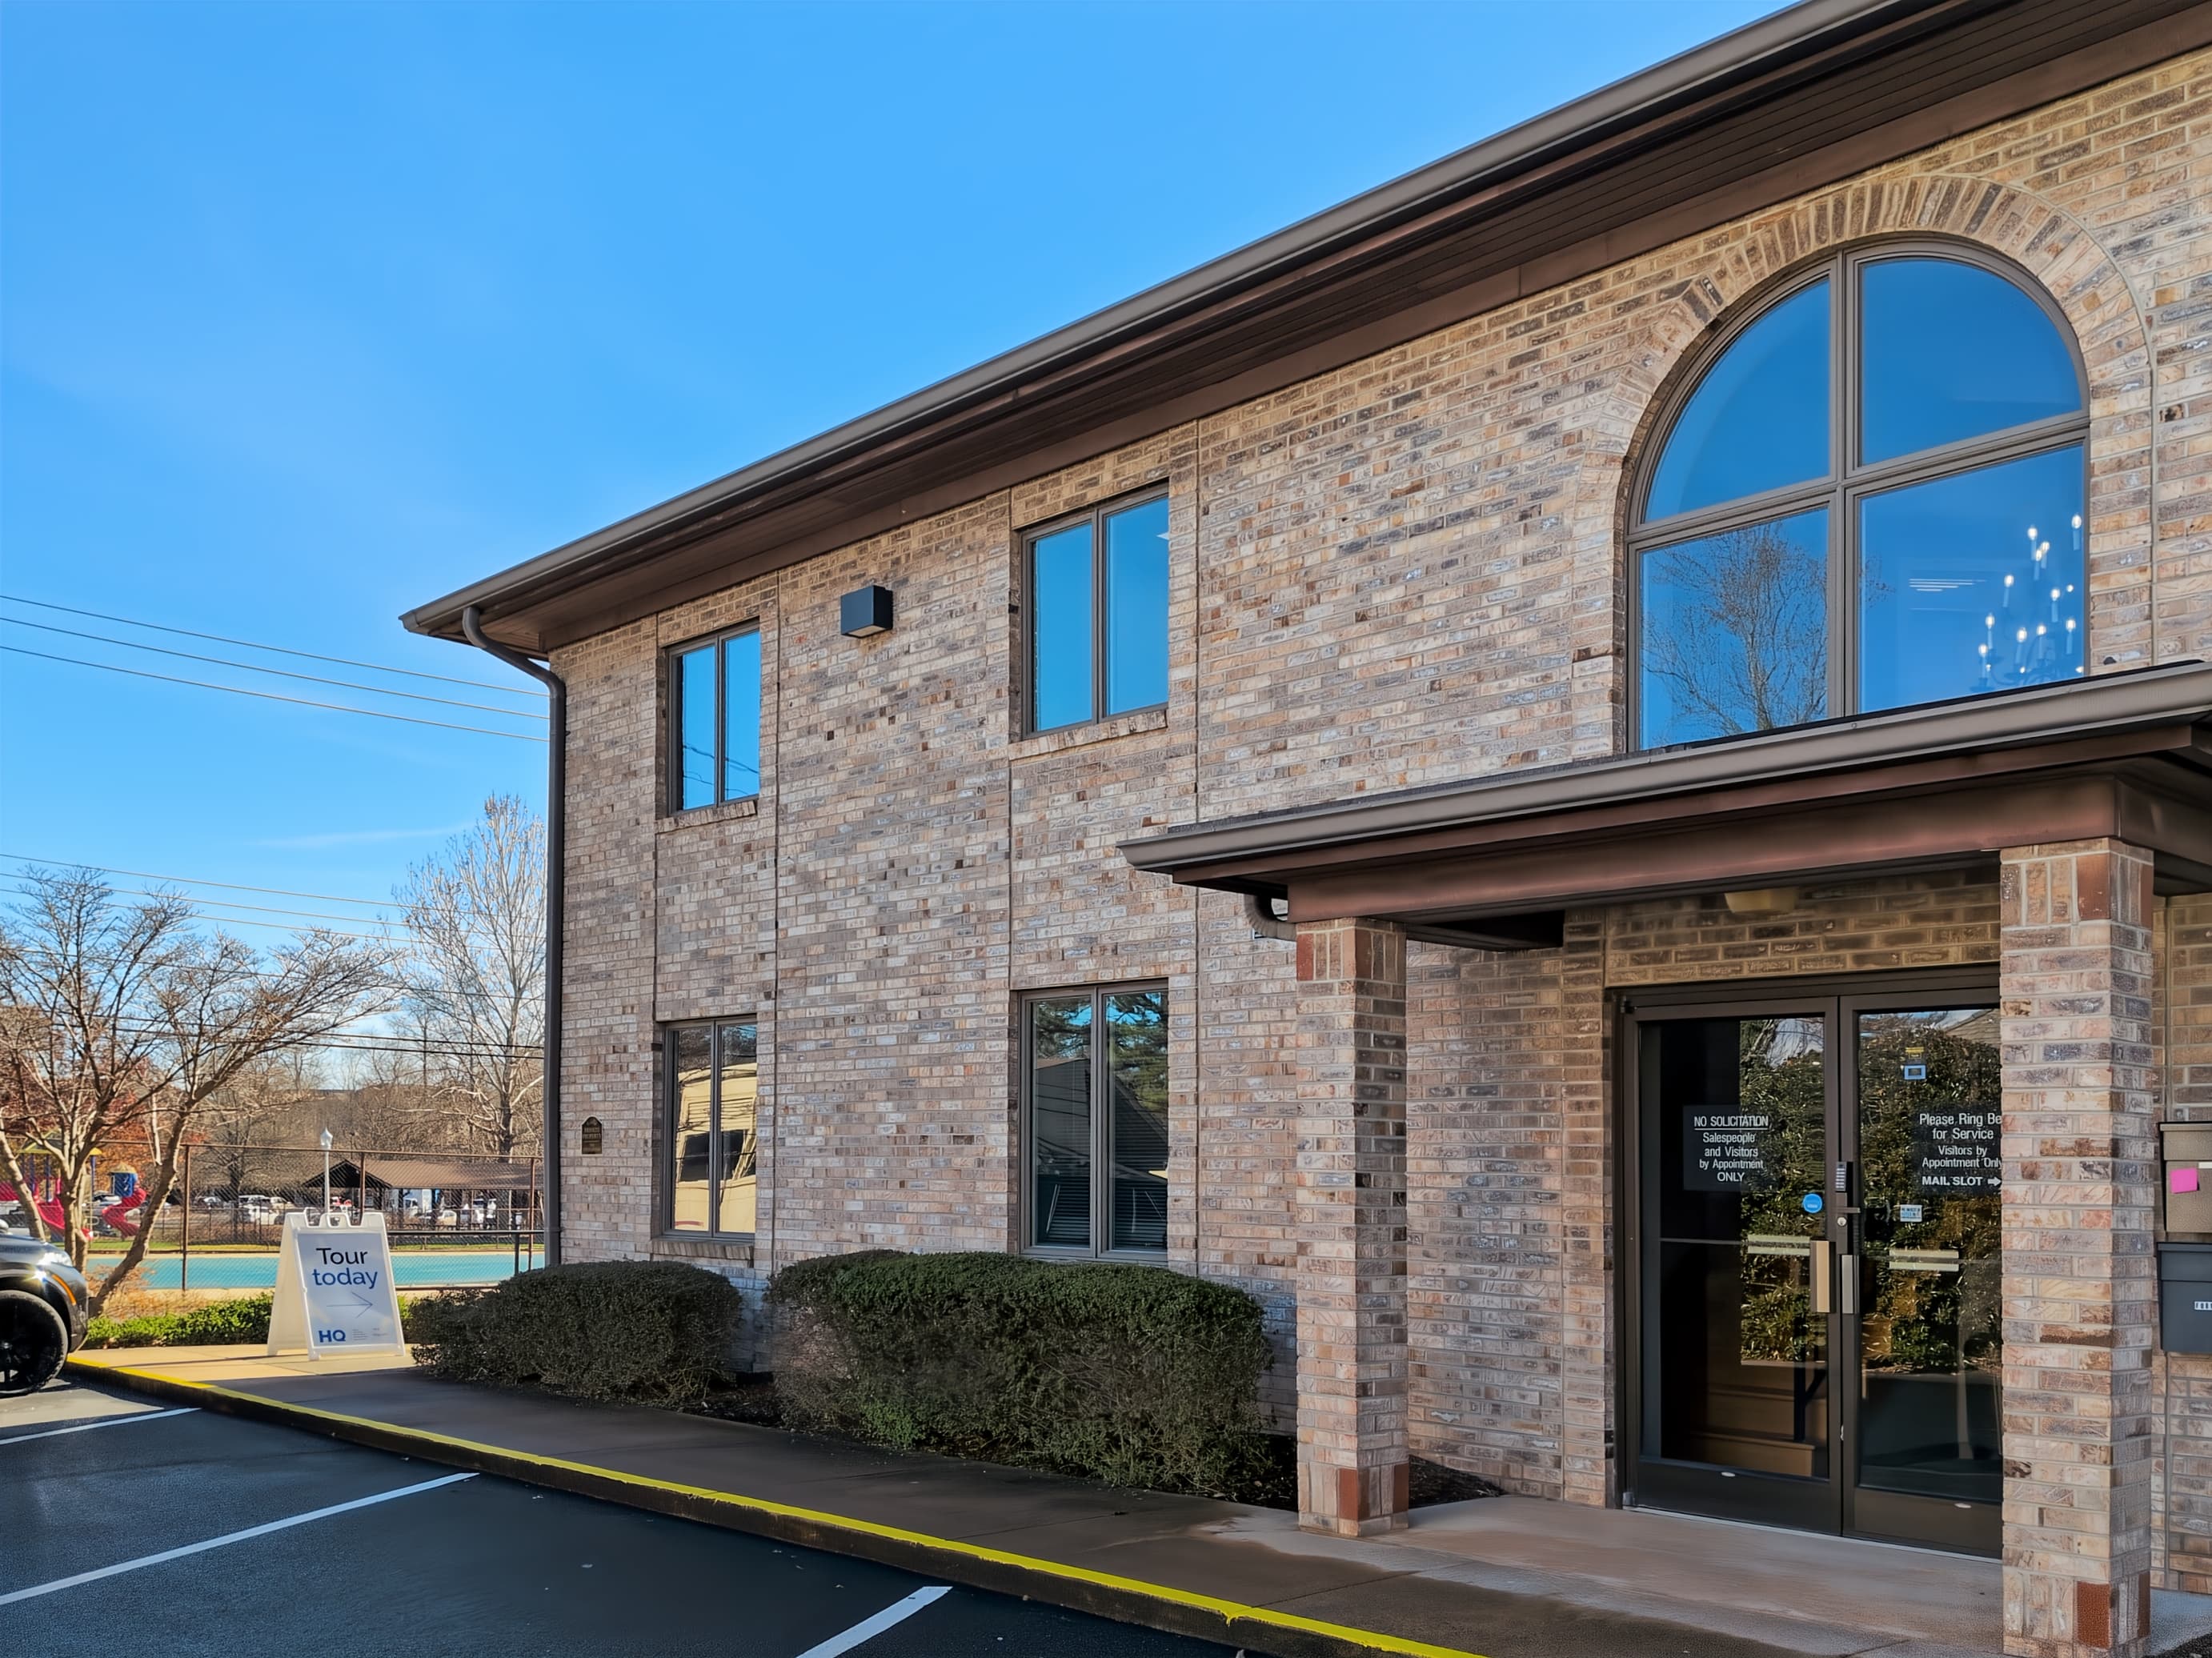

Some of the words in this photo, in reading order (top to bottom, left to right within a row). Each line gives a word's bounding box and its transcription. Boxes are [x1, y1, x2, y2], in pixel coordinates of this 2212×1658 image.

[1693, 1115, 1707, 1127] NO
[1710, 1115, 1769, 1127] SOLICITATION
[1919, 1113, 1954, 1125] Please
[1958, 1112, 1983, 1127] Ring
[1987, 1112, 2002, 1125] Be
[1702, 1131, 1756, 1145] Salespeople
[1932, 1127, 1948, 1139] for
[1953, 1127, 1994, 1139] Service
[1704, 1146, 1721, 1157] and
[1724, 1146, 1759, 1157] Visitors
[1938, 1145, 1973, 1155] Visitors
[1976, 1145, 1988, 1158] by
[1699, 1159, 1709, 1170] by
[1712, 1158, 1764, 1171] Appointment
[1921, 1157, 1980, 1169] Appointment
[1717, 1171, 1745, 1182] ONLY
[1921, 1175, 1950, 1186] MAIL
[1952, 1176, 1983, 1186] SLOT
[315, 1248, 368, 1265] Tour
[312, 1268, 379, 1289] today
[318, 1329, 347, 1343] HQ
